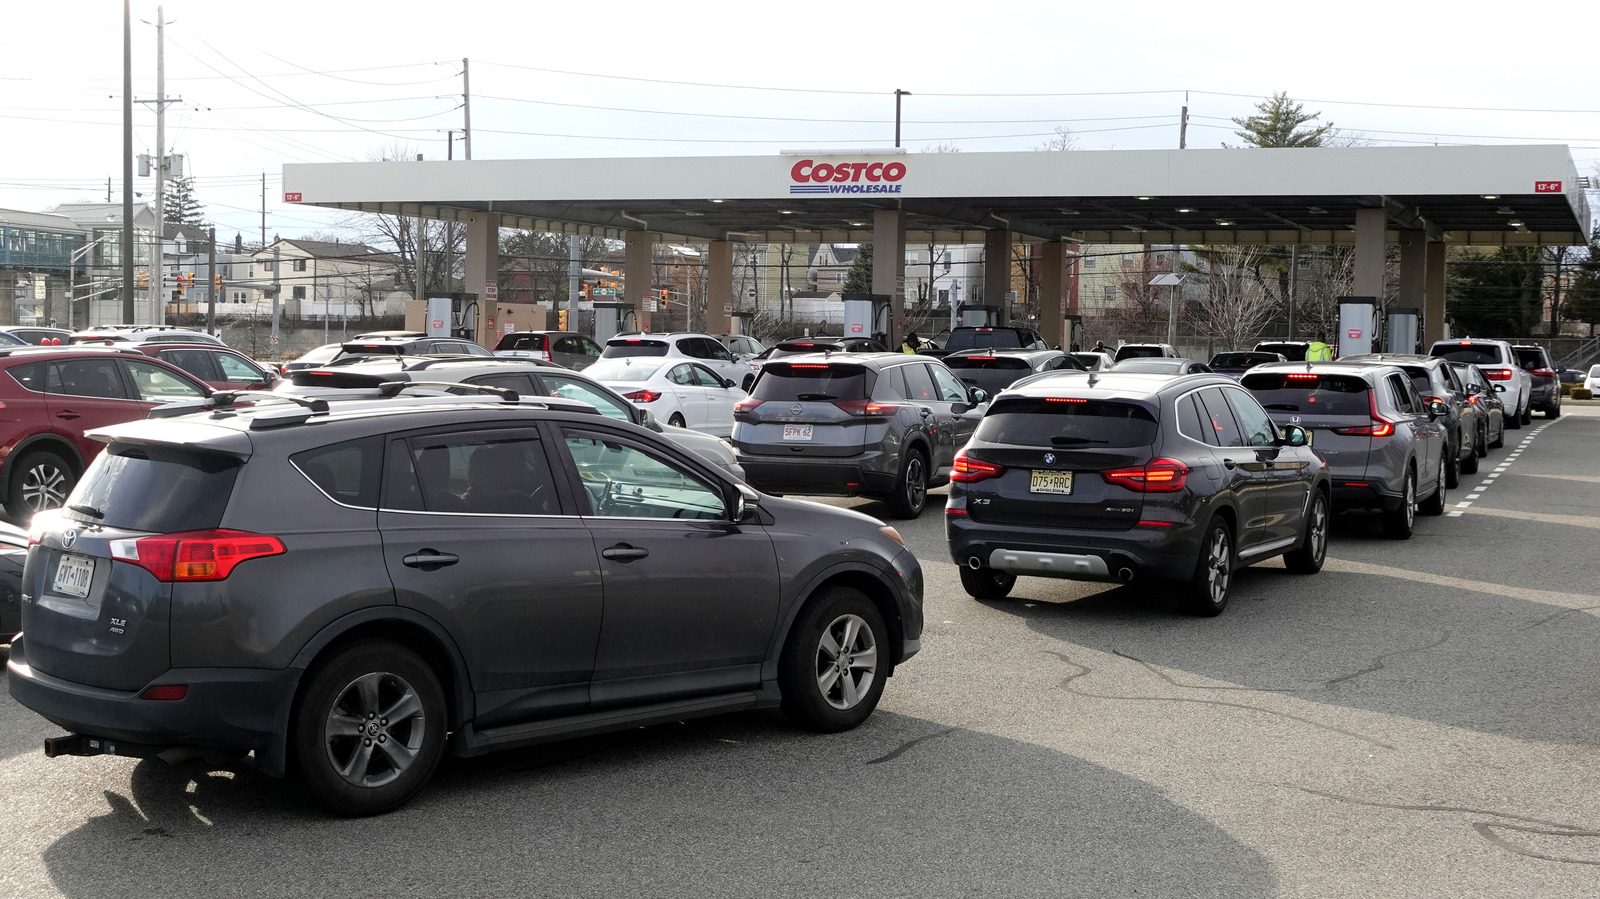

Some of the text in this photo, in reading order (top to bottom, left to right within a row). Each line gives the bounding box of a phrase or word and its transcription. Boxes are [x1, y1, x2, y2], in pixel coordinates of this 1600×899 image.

[791, 159, 907, 183] COSTCO
[829, 184, 902, 194] WHOLESALE
[802, 428, 812, 436] 62
[110, 618, 126, 626] XLE
